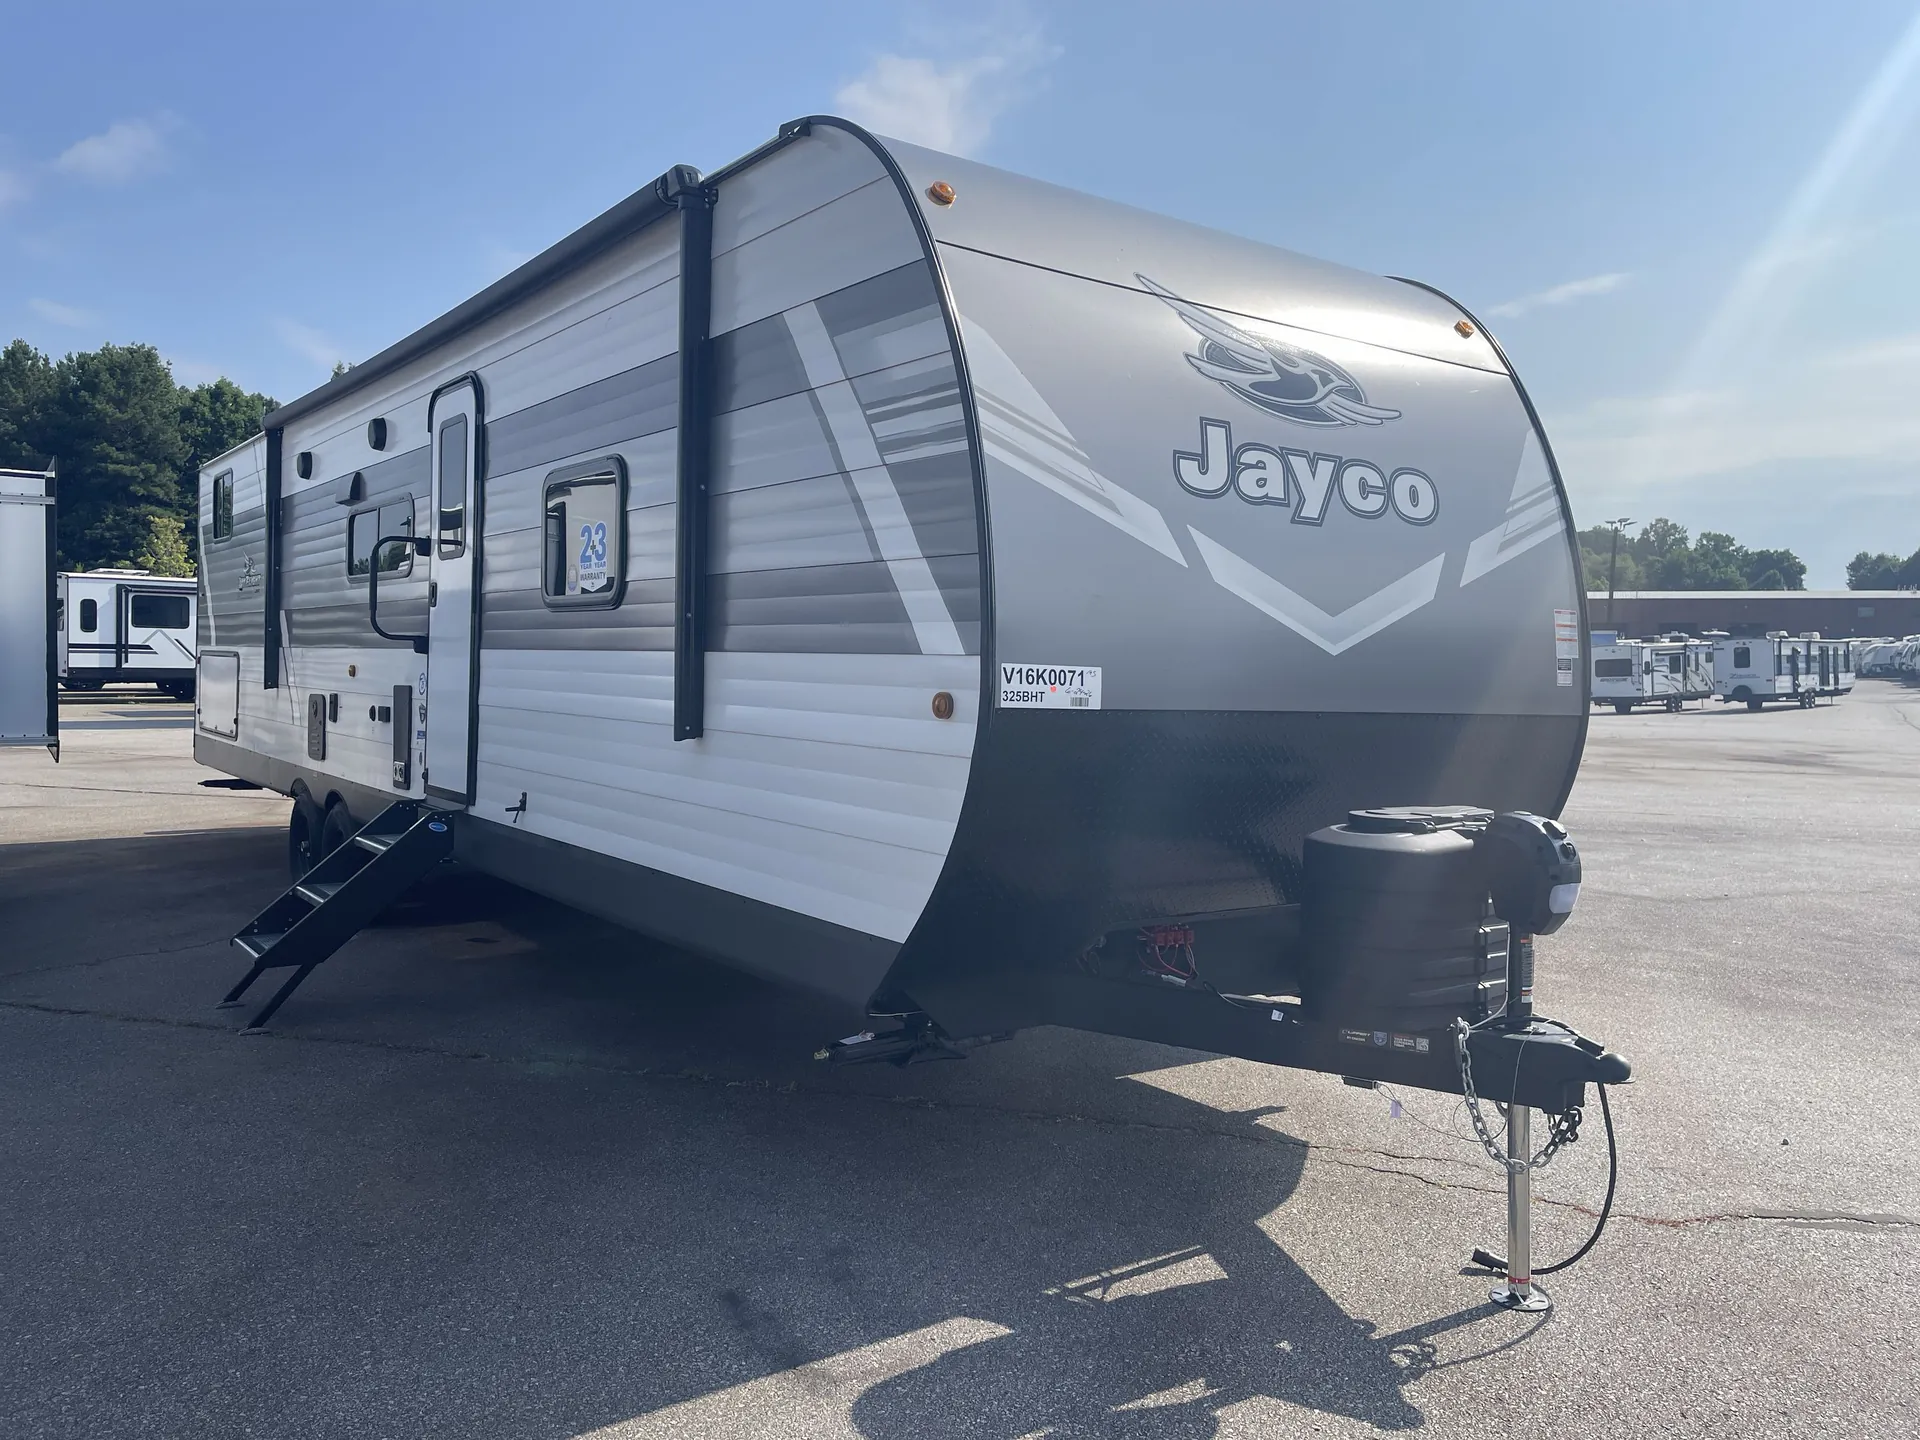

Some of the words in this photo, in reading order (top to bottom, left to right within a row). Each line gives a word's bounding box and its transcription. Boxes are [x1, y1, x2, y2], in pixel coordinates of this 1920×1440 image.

[1173, 416, 1439, 527] Jayco
[594, 561, 606, 569] YEAR
[580, 571, 607, 582] WARRANTY
[1002, 666, 1084, 686] V16K0071
[1002, 690, 1045, 703] 325BHT
